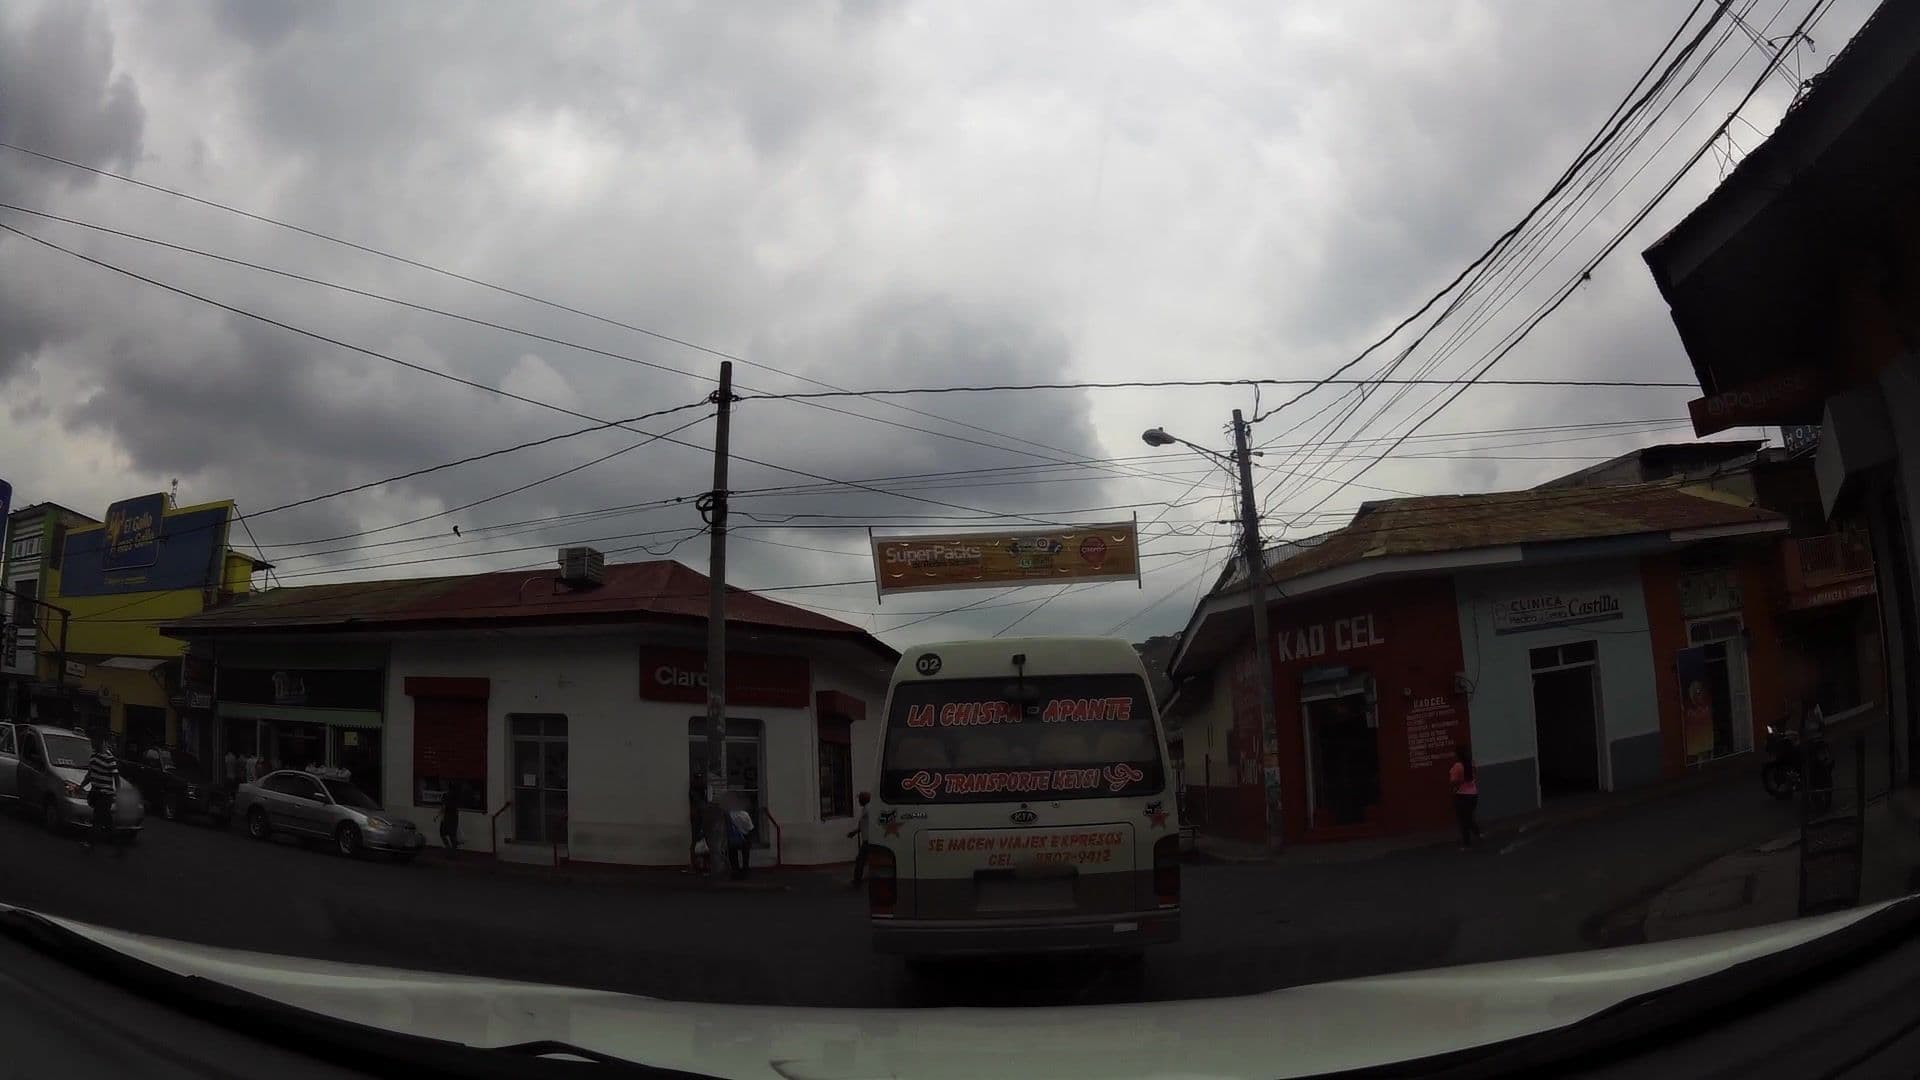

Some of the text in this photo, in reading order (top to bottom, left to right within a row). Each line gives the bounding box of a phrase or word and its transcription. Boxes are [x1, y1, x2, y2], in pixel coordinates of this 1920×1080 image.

[886, 545, 981, 566] SuperPacks
[1569, 595, 1620, 616] Castilla
[1335, 613, 1385, 652] CEL
[919, 658, 941, 672] 02
[907, 704, 934, 727] LA
[940, 700, 1023, 726] CHISPA
[1043, 697, 1132, 722] APANTE
[944, 770, 1051, 794] TRANSPORTE
[928, 832, 1123, 851] SE HACEN VIAJES EXPRESOS
